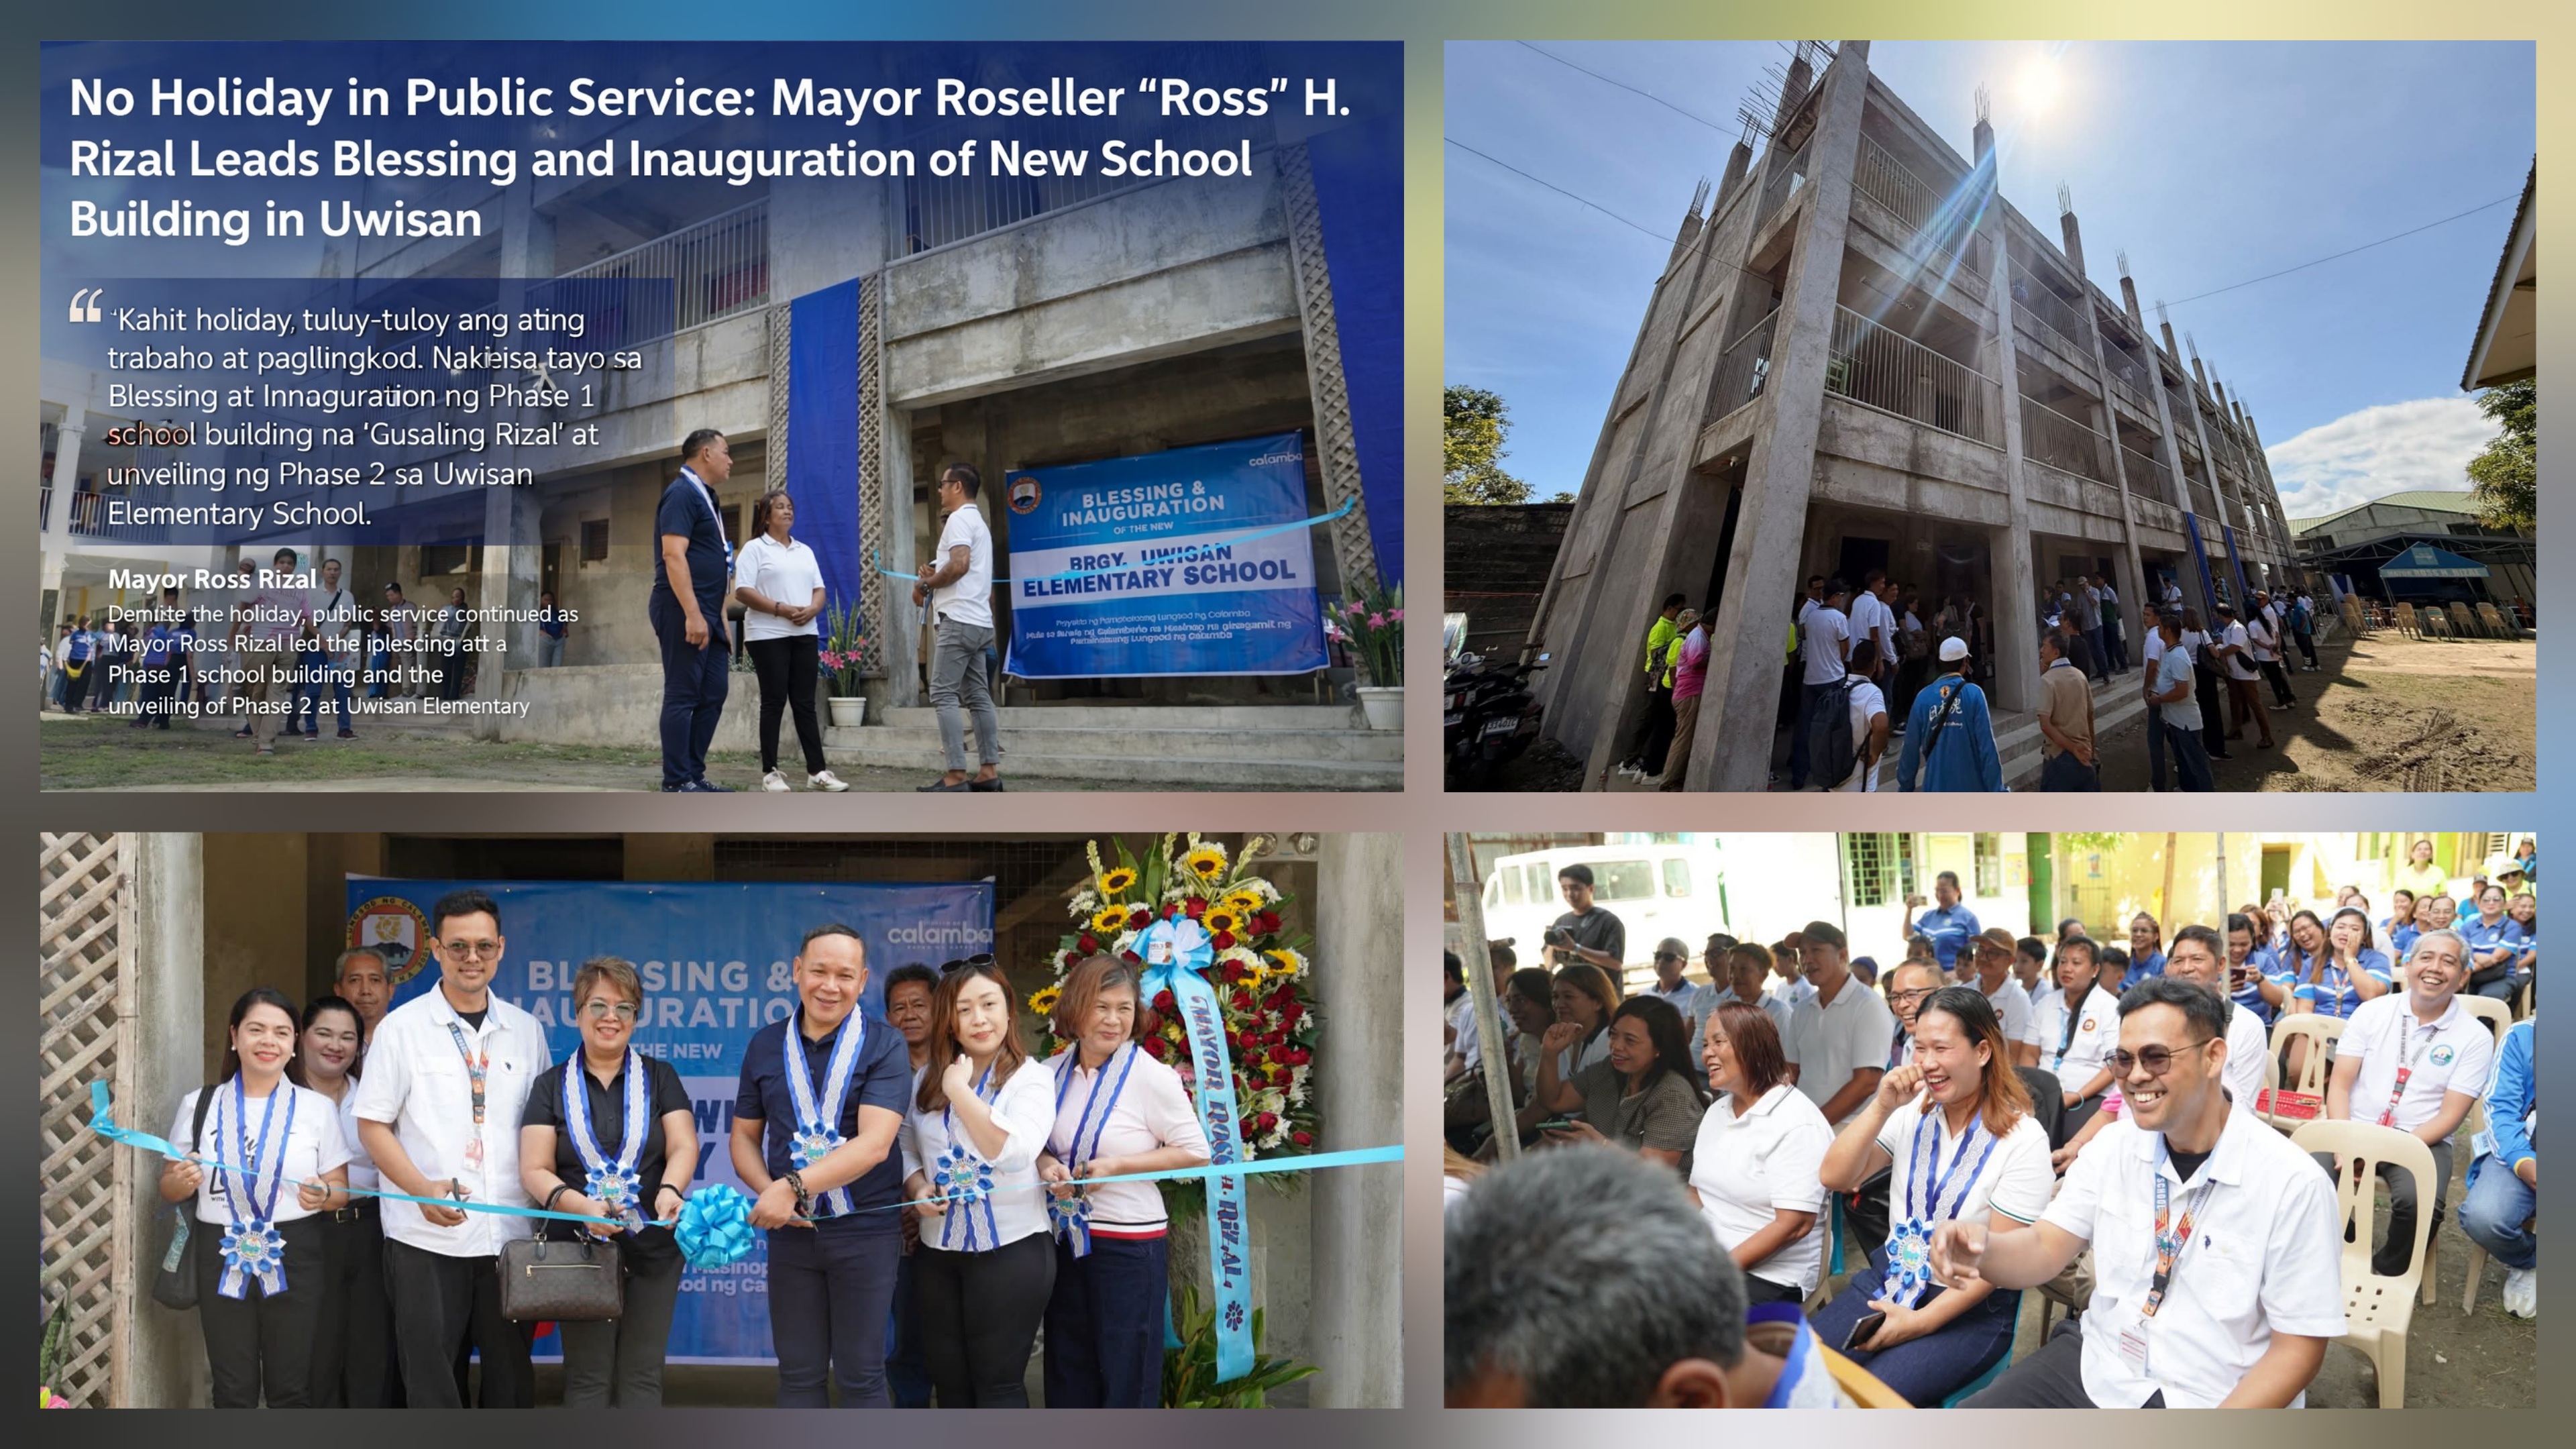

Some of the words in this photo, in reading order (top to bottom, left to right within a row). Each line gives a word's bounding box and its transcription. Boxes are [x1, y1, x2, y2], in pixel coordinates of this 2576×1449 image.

[1082, 482, 1183, 508] BLESSING
[1191, 480, 1205, 495] &
[1062, 494, 1225, 527] INAUGURATION
[1114, 526, 1126, 535] OF
[1128, 523, 1148, 533] THE
[1150, 521, 1174, 531] NEW
[1140, 543, 1232, 566] UWISAN
[1024, 568, 1175, 597] ELEMENTARY
[1183, 559, 1296, 586] SCHOOL
[888, 920, 994, 944] calamba
[528, 961, 749, 991] BLSING
[673, 1043, 722, 1059] NEW
[2156, 1177, 2166, 1210] SCHOOL
[711, 1279, 737, 1297] ng
